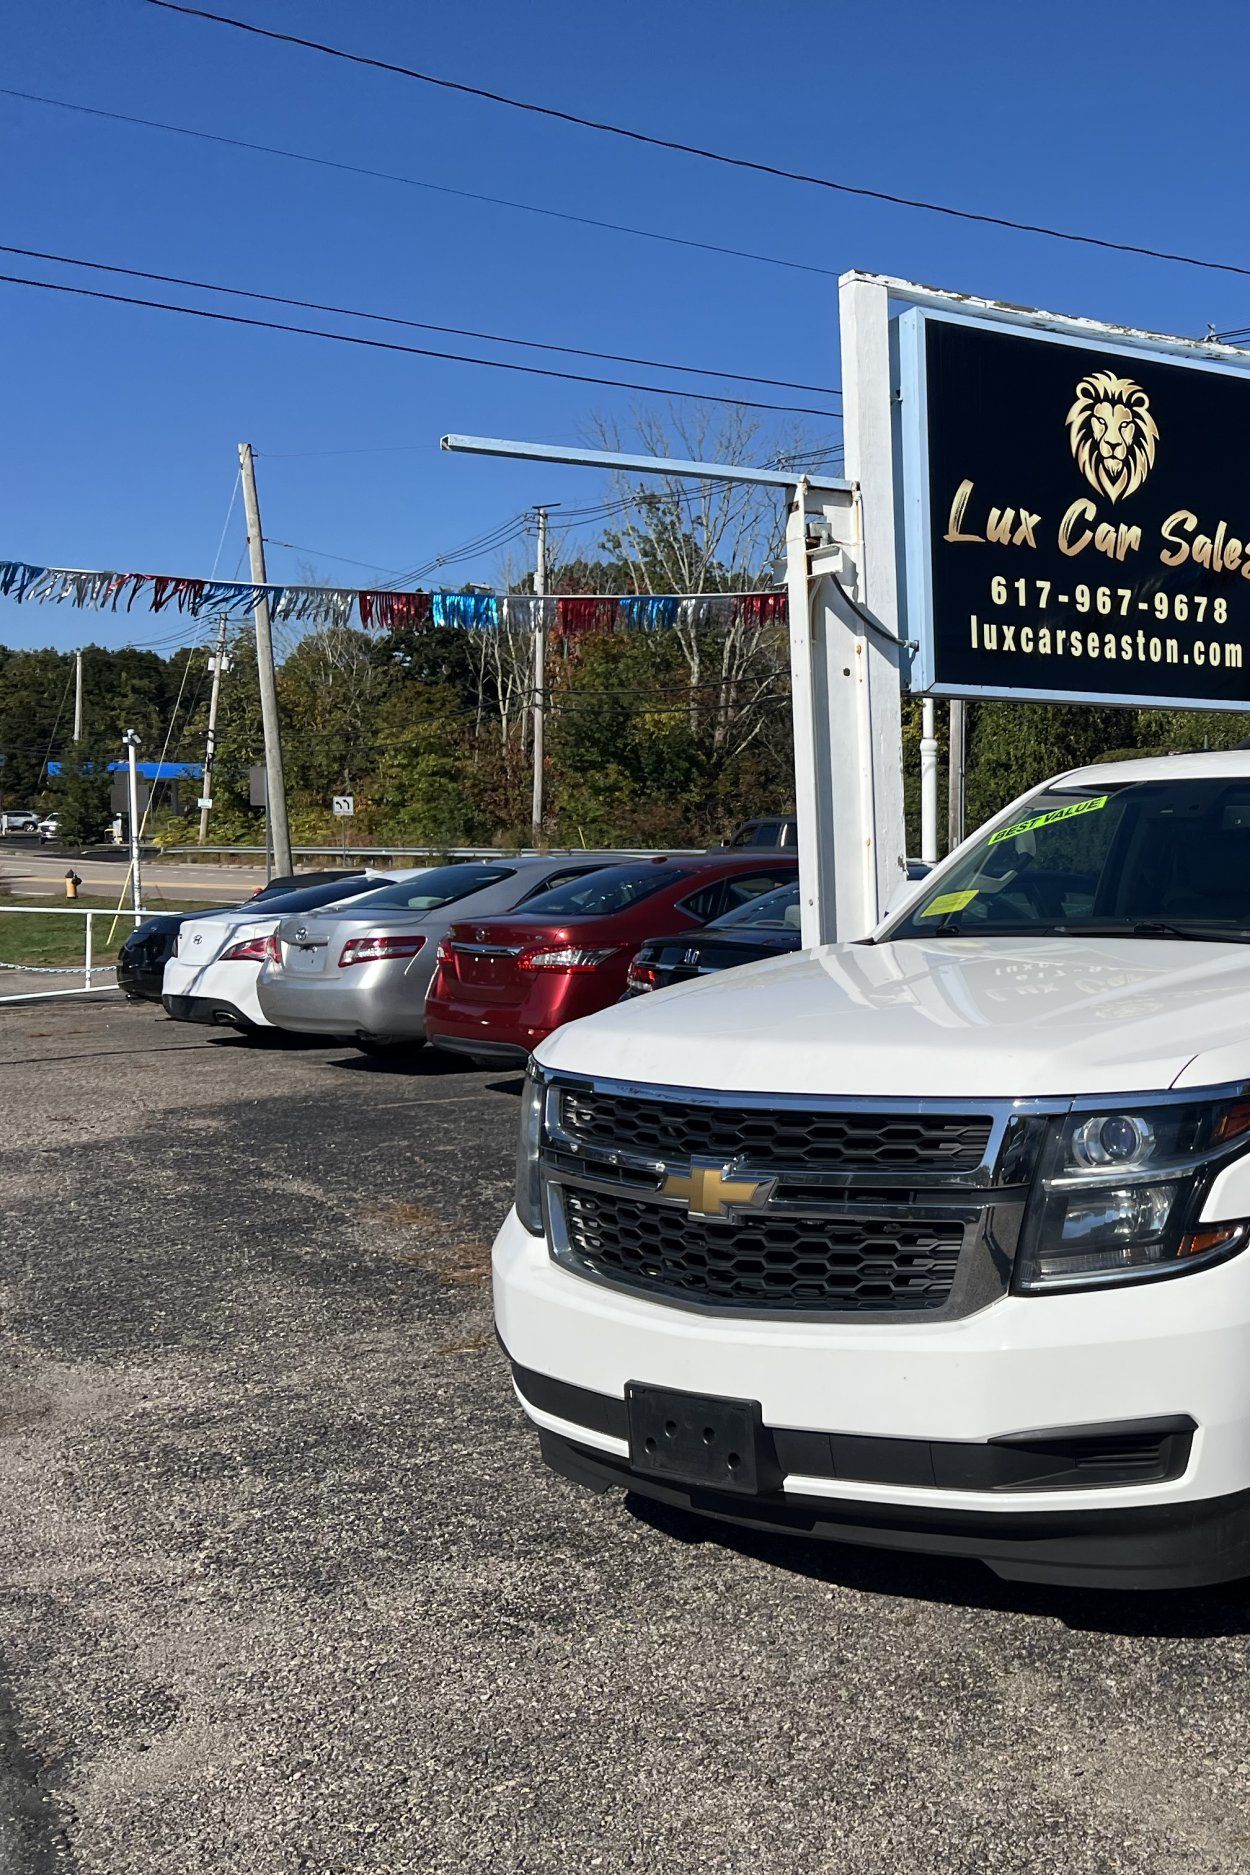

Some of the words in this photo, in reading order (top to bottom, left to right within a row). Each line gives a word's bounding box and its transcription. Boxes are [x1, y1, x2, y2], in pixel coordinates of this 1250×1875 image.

[943, 479, 1041, 549] Lux
[1058, 498, 1141, 562] Car
[991, 576, 1228, 624] 617-967-9678
[970, 615, 1243, 668] luxcarseaston.com
[993, 818, 1041, 840] BEST
[1044, 799, 1098, 822] VALUE
